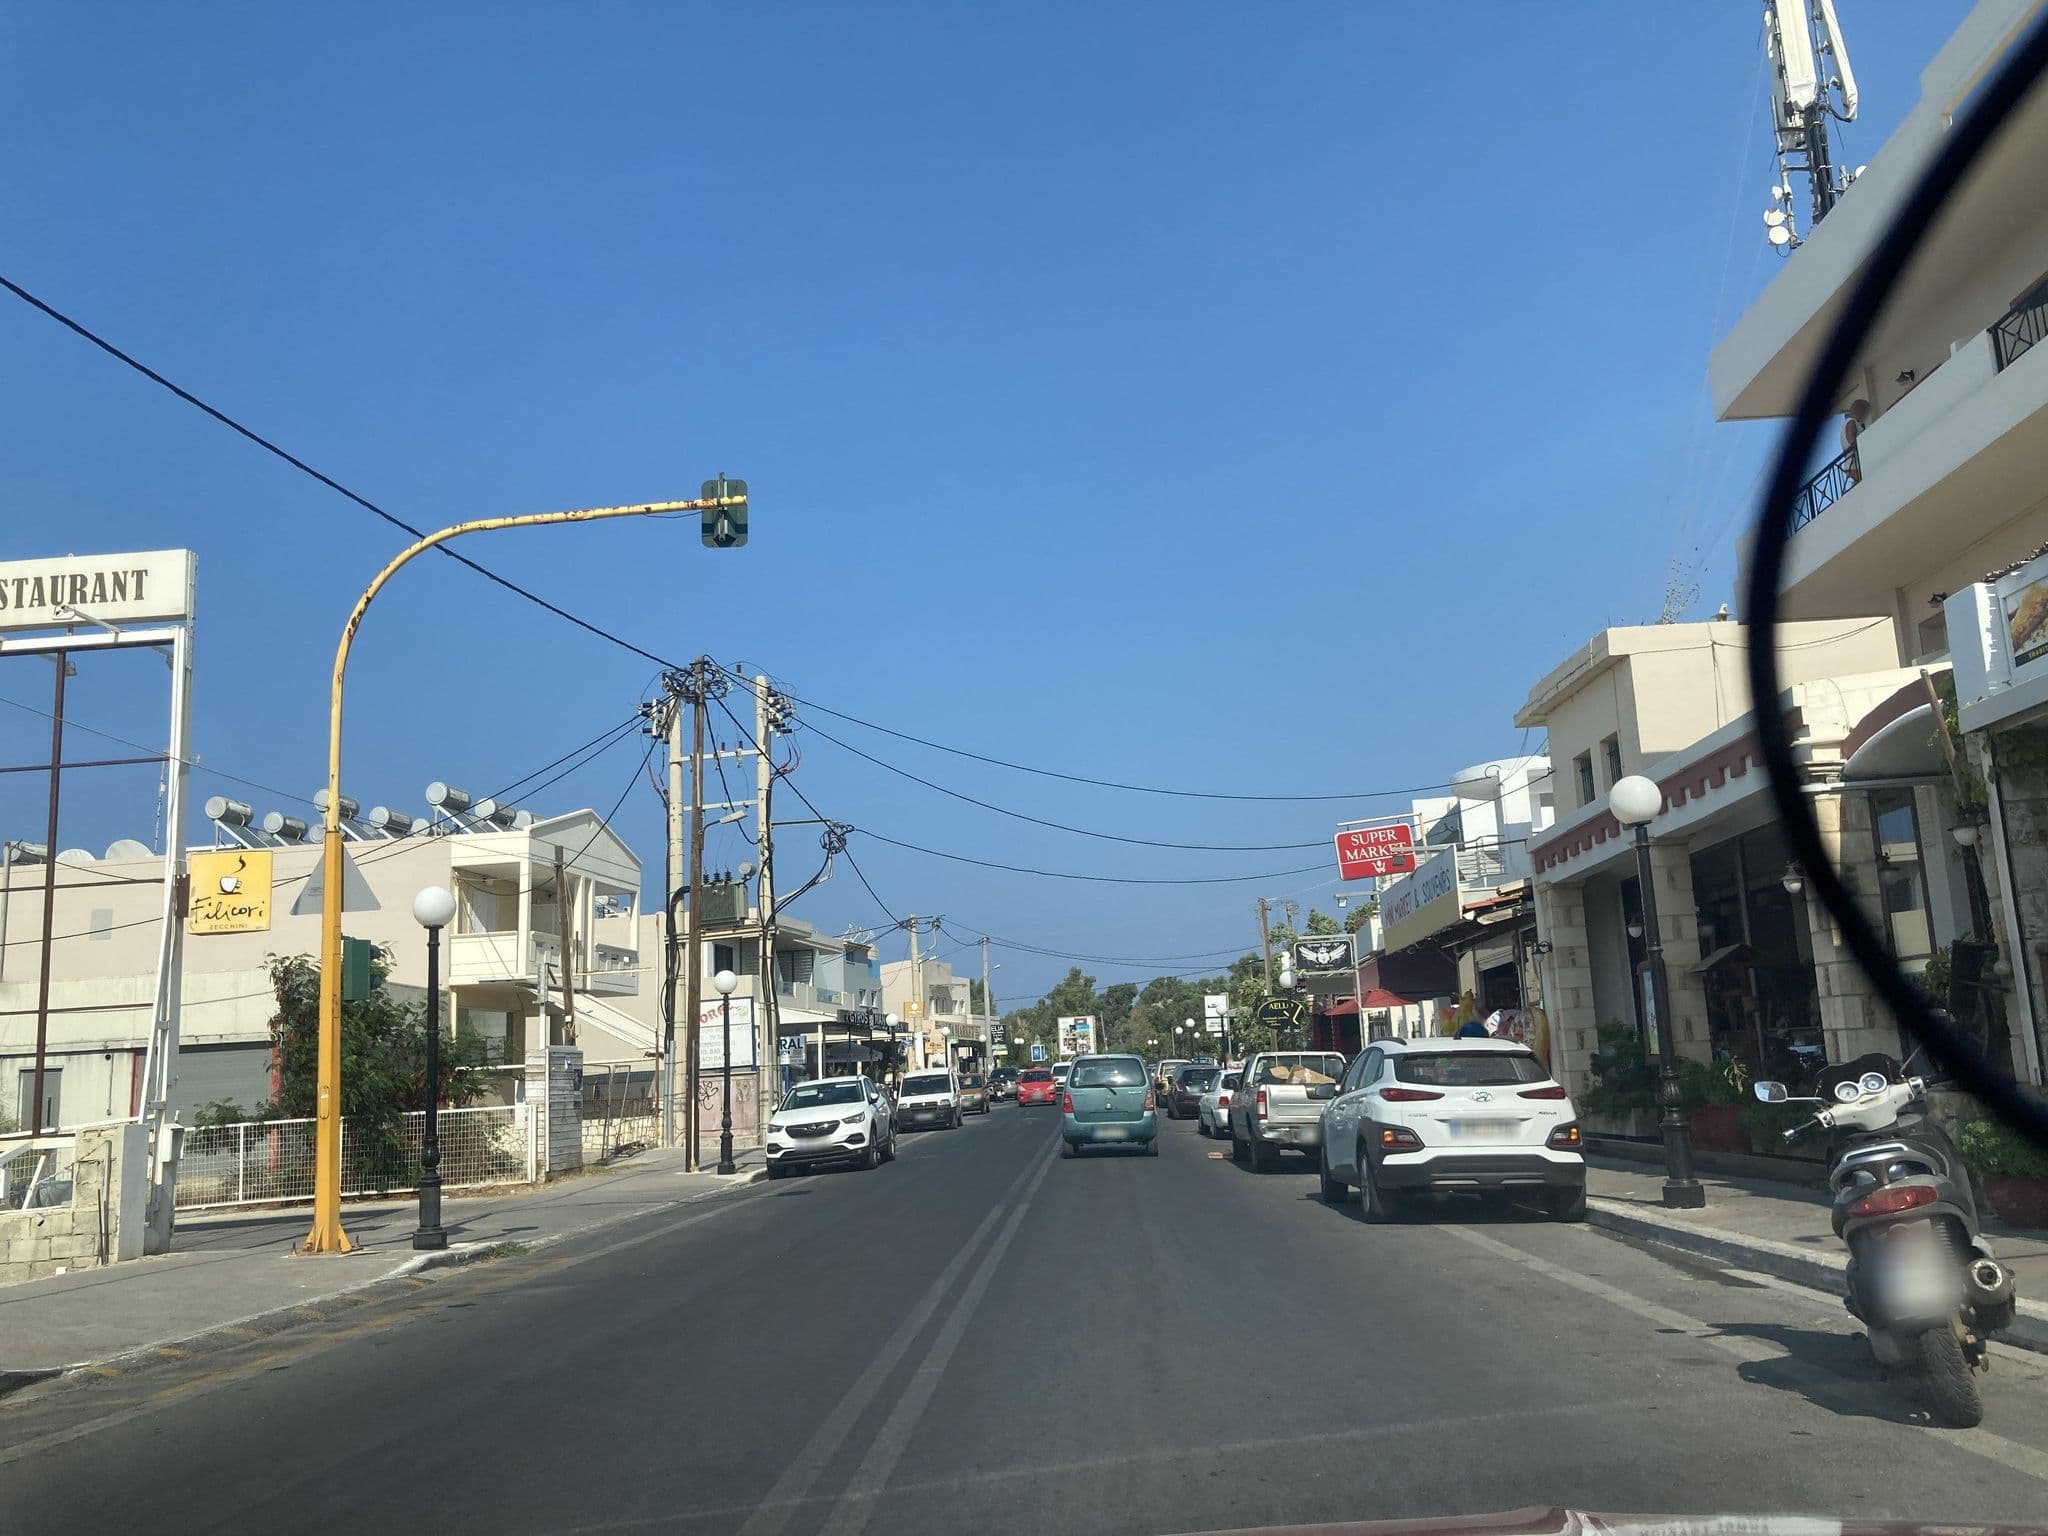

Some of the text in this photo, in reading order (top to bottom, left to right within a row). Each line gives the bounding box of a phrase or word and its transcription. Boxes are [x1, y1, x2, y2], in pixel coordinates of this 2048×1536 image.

[1350, 829, 1398, 846] SUPER
[191, 897, 265, 924] Filicori
[209, 923, 248, 931] ZECCHINI
